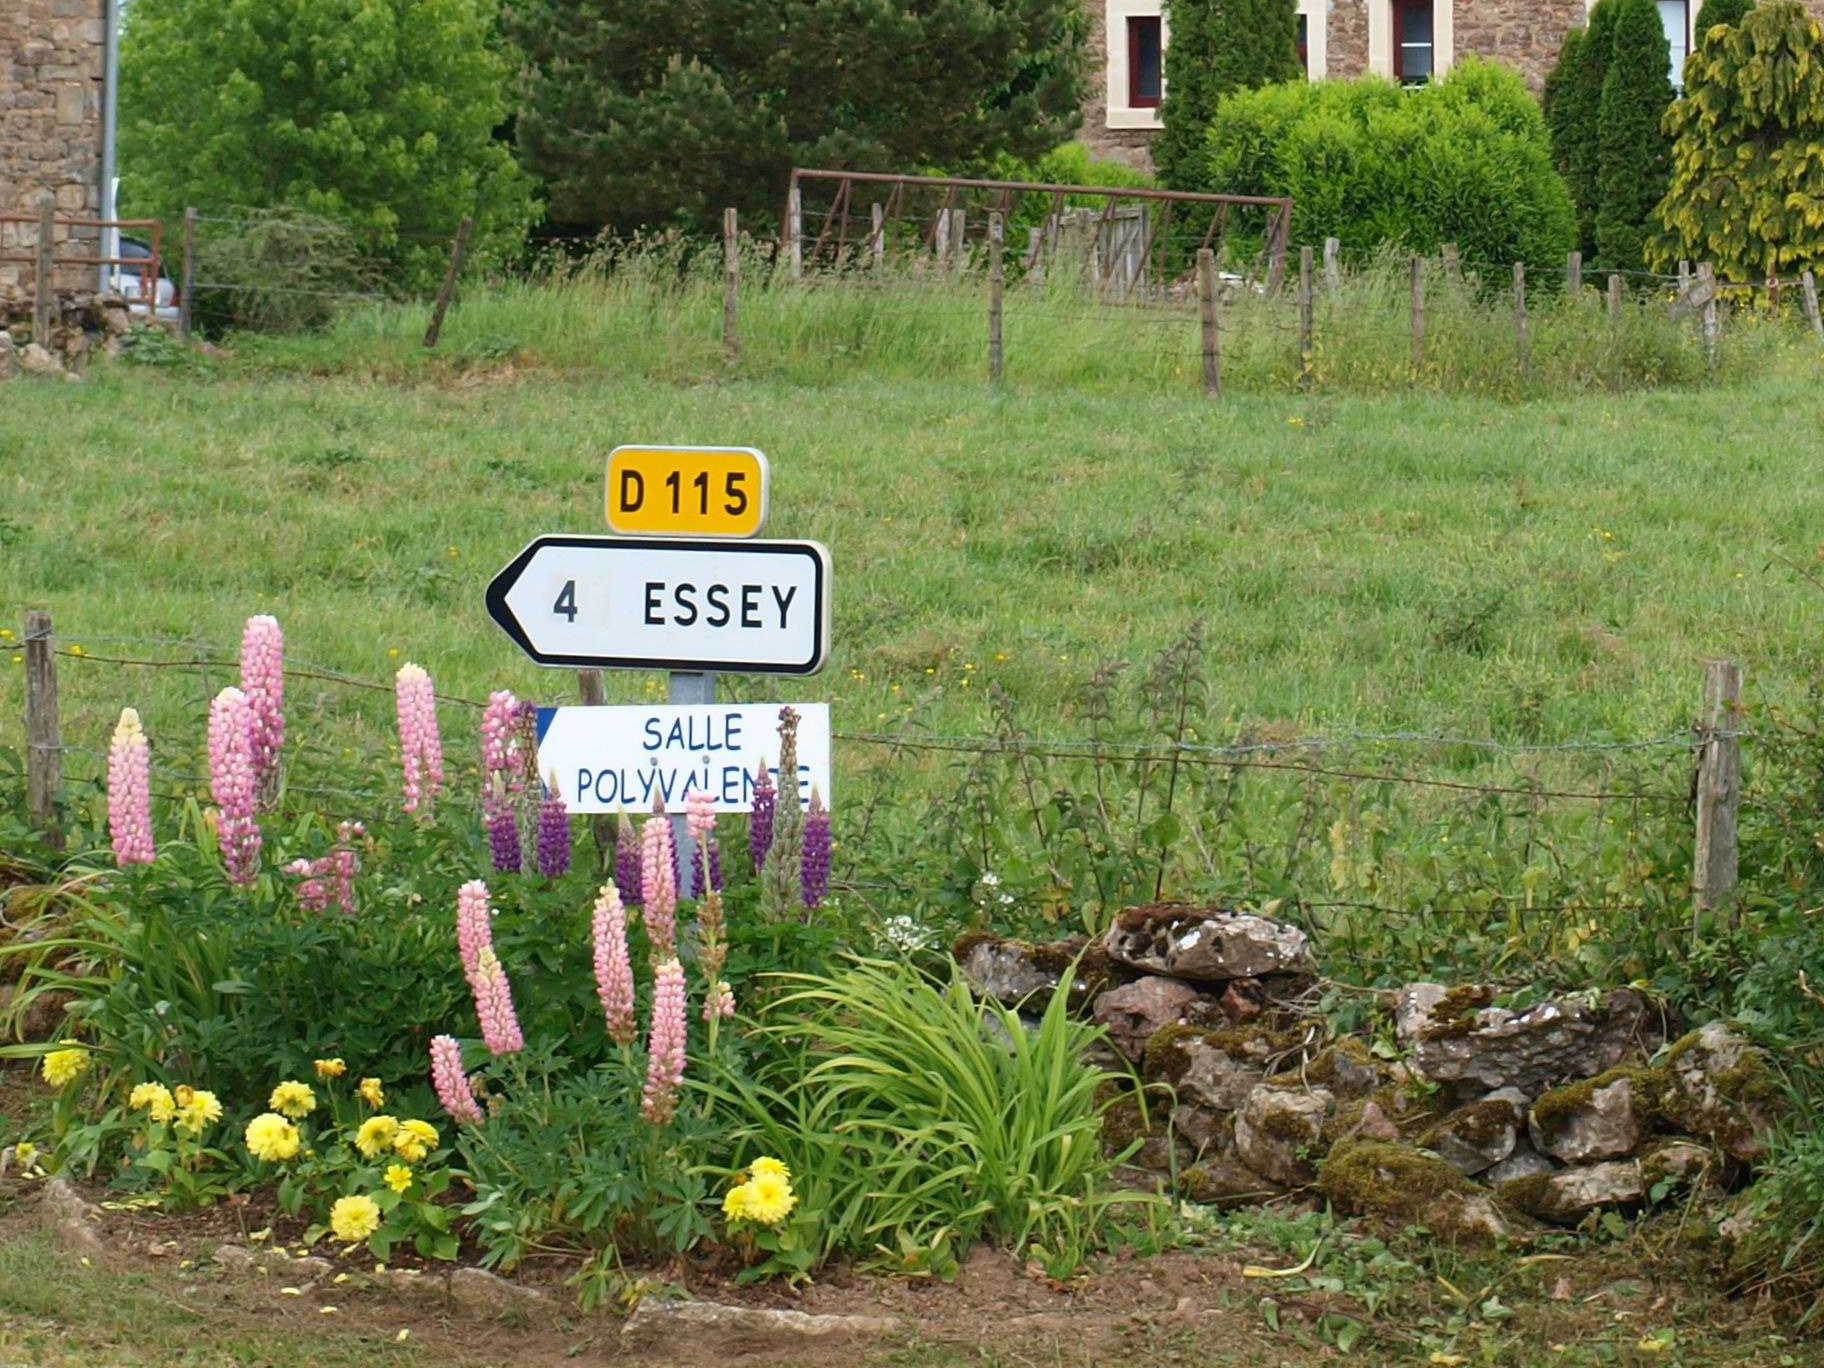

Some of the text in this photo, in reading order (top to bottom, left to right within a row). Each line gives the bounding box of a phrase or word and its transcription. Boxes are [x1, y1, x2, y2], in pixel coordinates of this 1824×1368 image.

[619, 469, 748, 516] D 115
[553, 579, 798, 629] 4 ESSEY
[642, 713, 743, 751] SALLE
